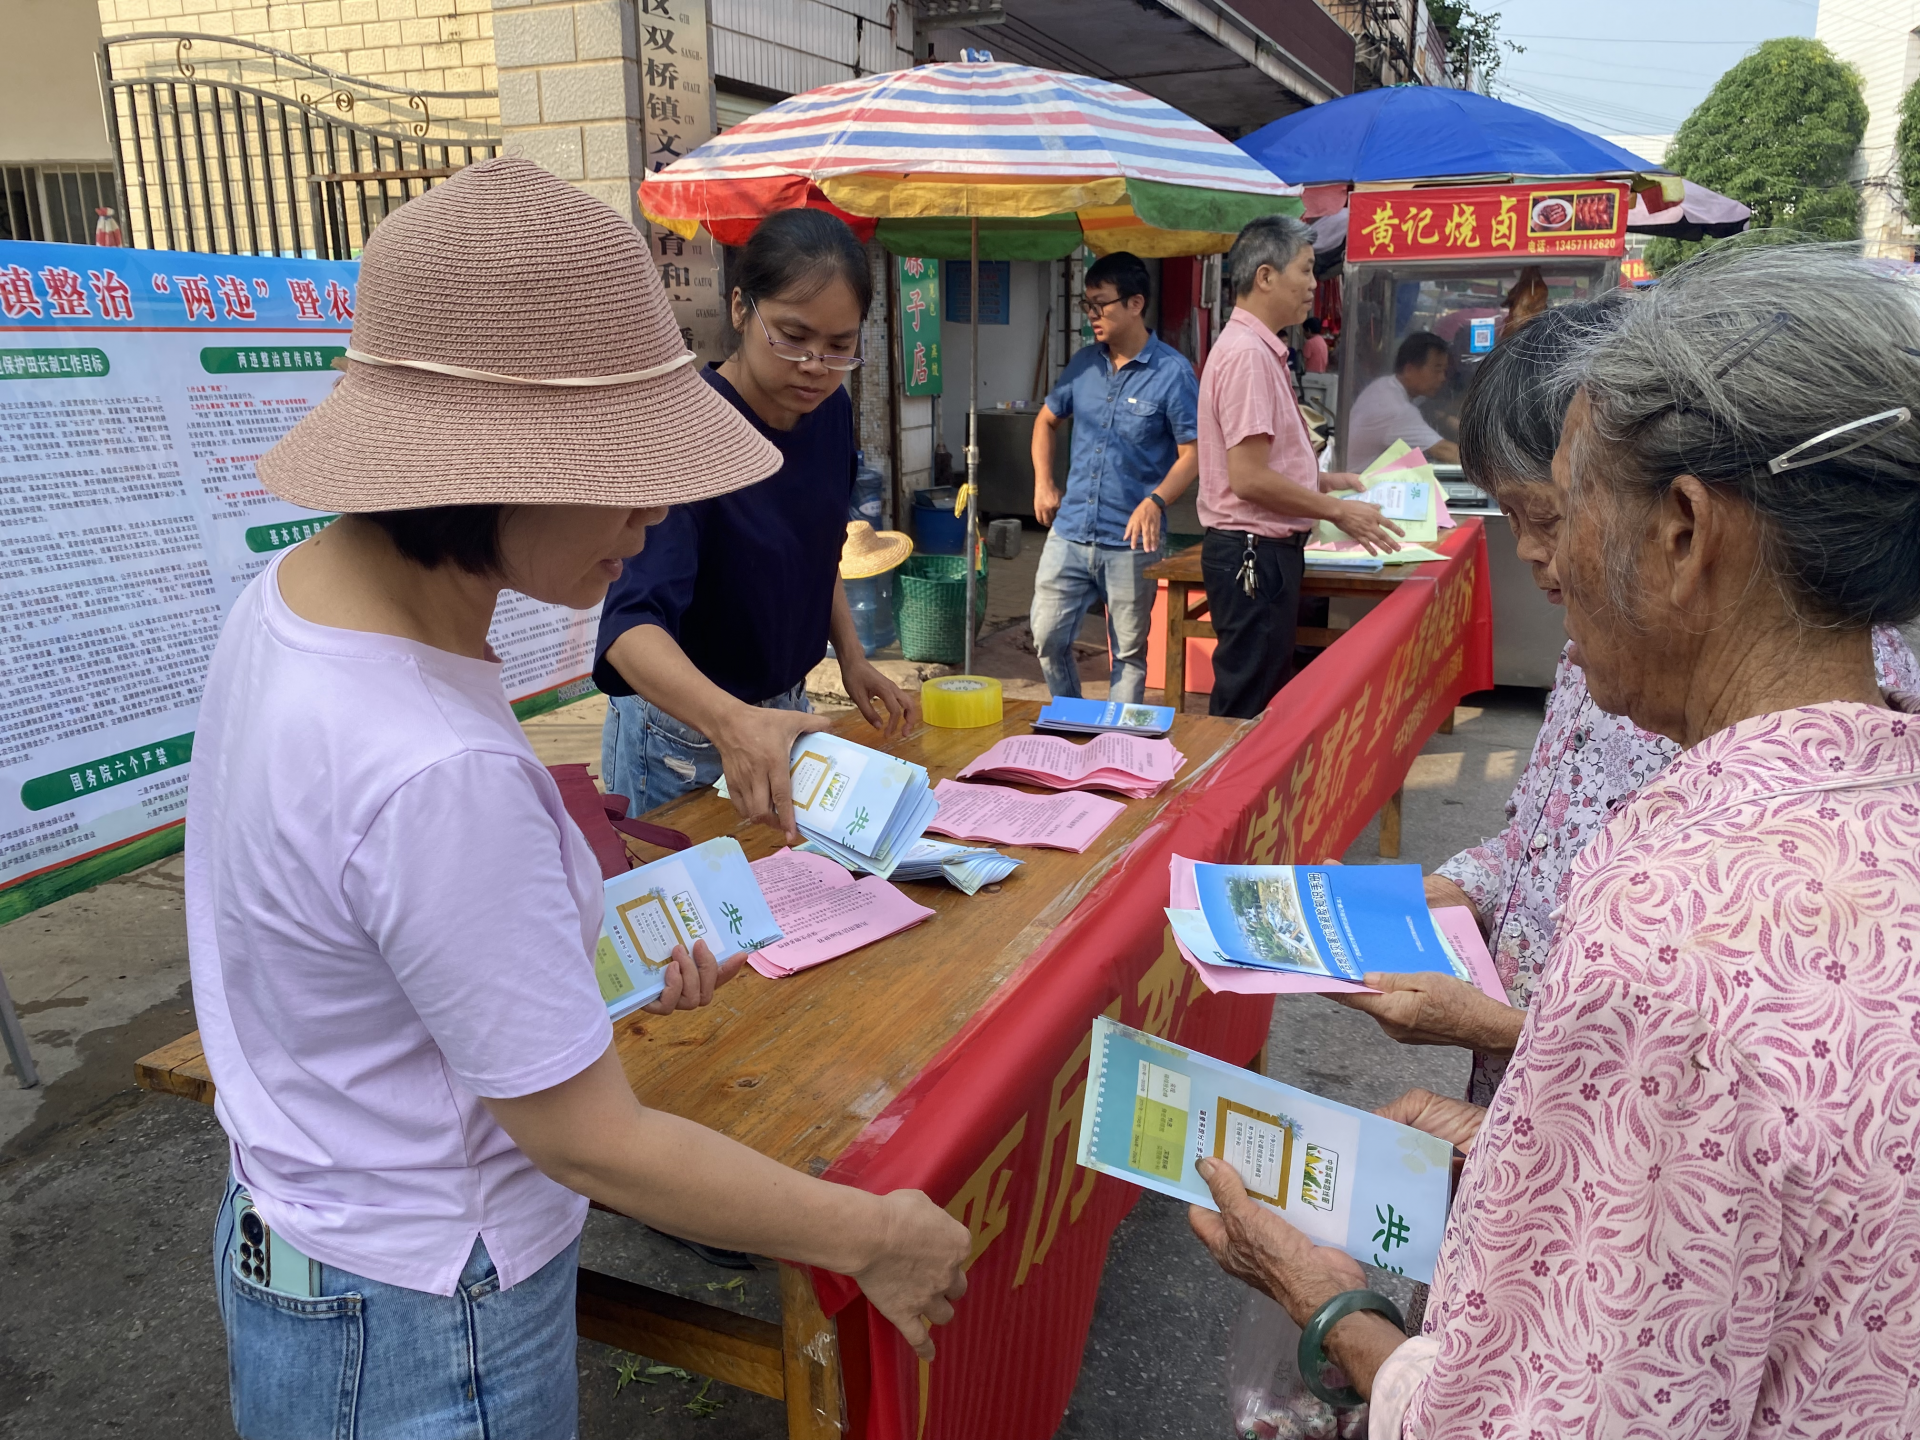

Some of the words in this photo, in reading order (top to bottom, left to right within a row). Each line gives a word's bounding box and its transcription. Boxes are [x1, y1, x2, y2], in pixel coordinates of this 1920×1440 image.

[1362, 194, 1518, 256] 黄记烧卤
[0, 353, 104, 375] 保护田长制工作目标
[236, 350, 323, 370] 两违整治宣传问答
[70, 746, 168, 792] 国务院六个严禁
[1321, 1159, 1335, 1205] 中国减碳路线图
